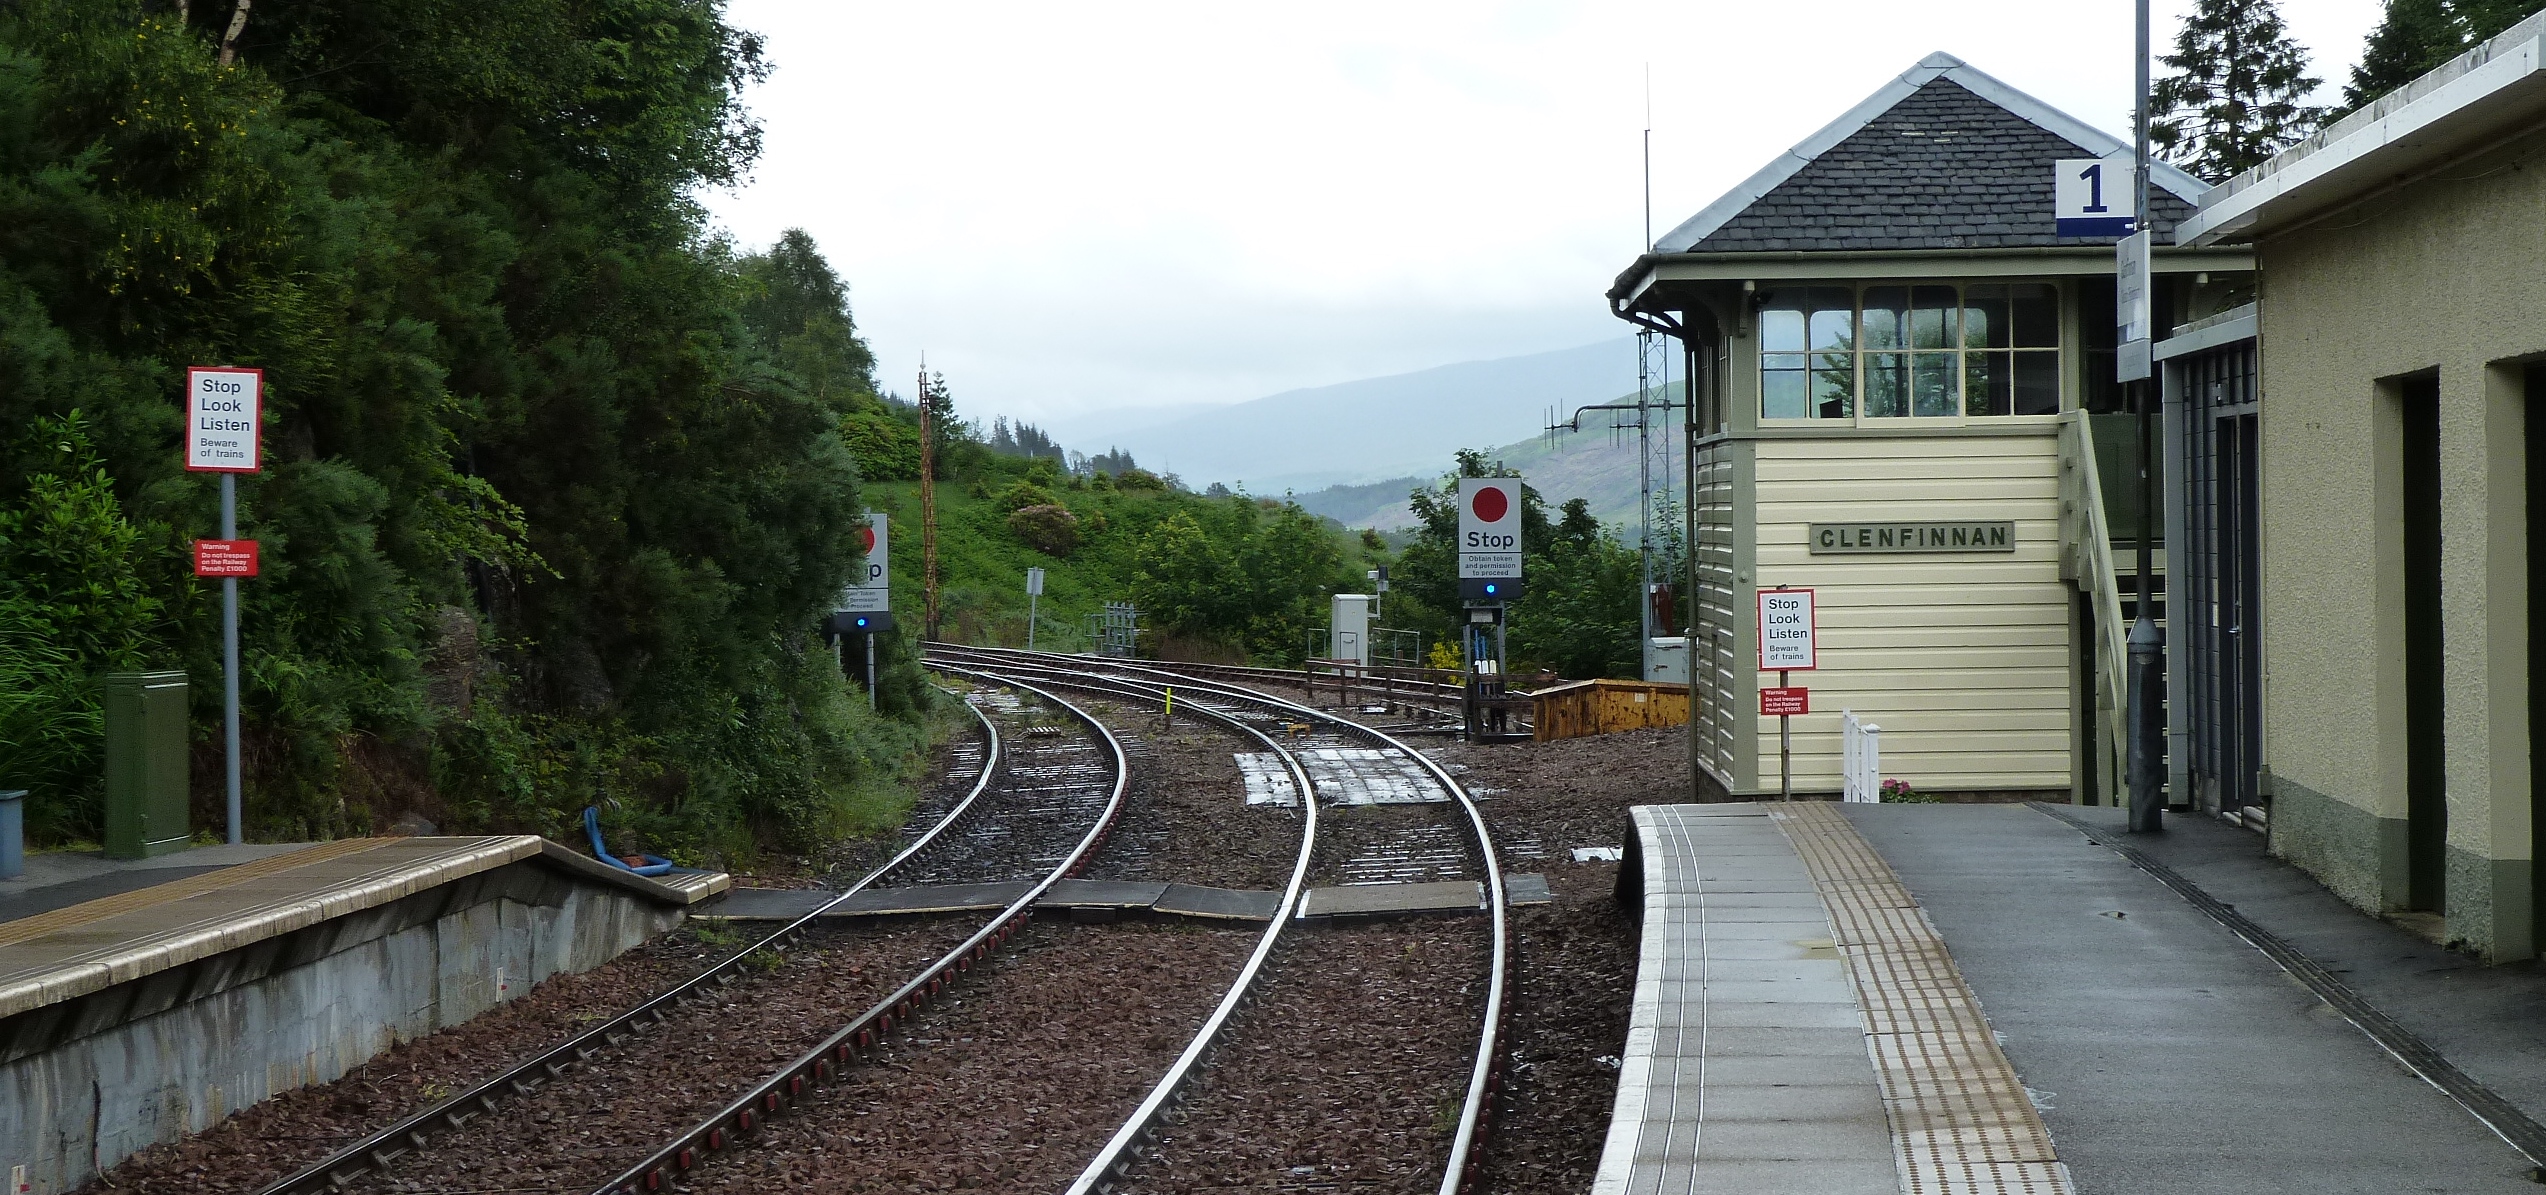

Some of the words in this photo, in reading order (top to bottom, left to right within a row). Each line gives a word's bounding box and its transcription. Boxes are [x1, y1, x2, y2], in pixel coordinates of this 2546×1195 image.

[2079, 164, 2108, 213] 1
[202, 379, 241, 395] Stop
[201, 398, 242, 412] Look
[201, 417, 250, 432] Listen
[200, 438, 238, 448] Beware
[200, 449, 211, 457] of
[216, 449, 244, 459] trains
[1467, 531, 1514, 549] Stop
[1820, 527, 2006, 548] GLENFINNAN
[201, 543, 230, 551] Warning
[1769, 598, 1799, 611] Stop
[1769, 613, 1800, 624] Look
[1769, 628, 1808, 639] Listen
